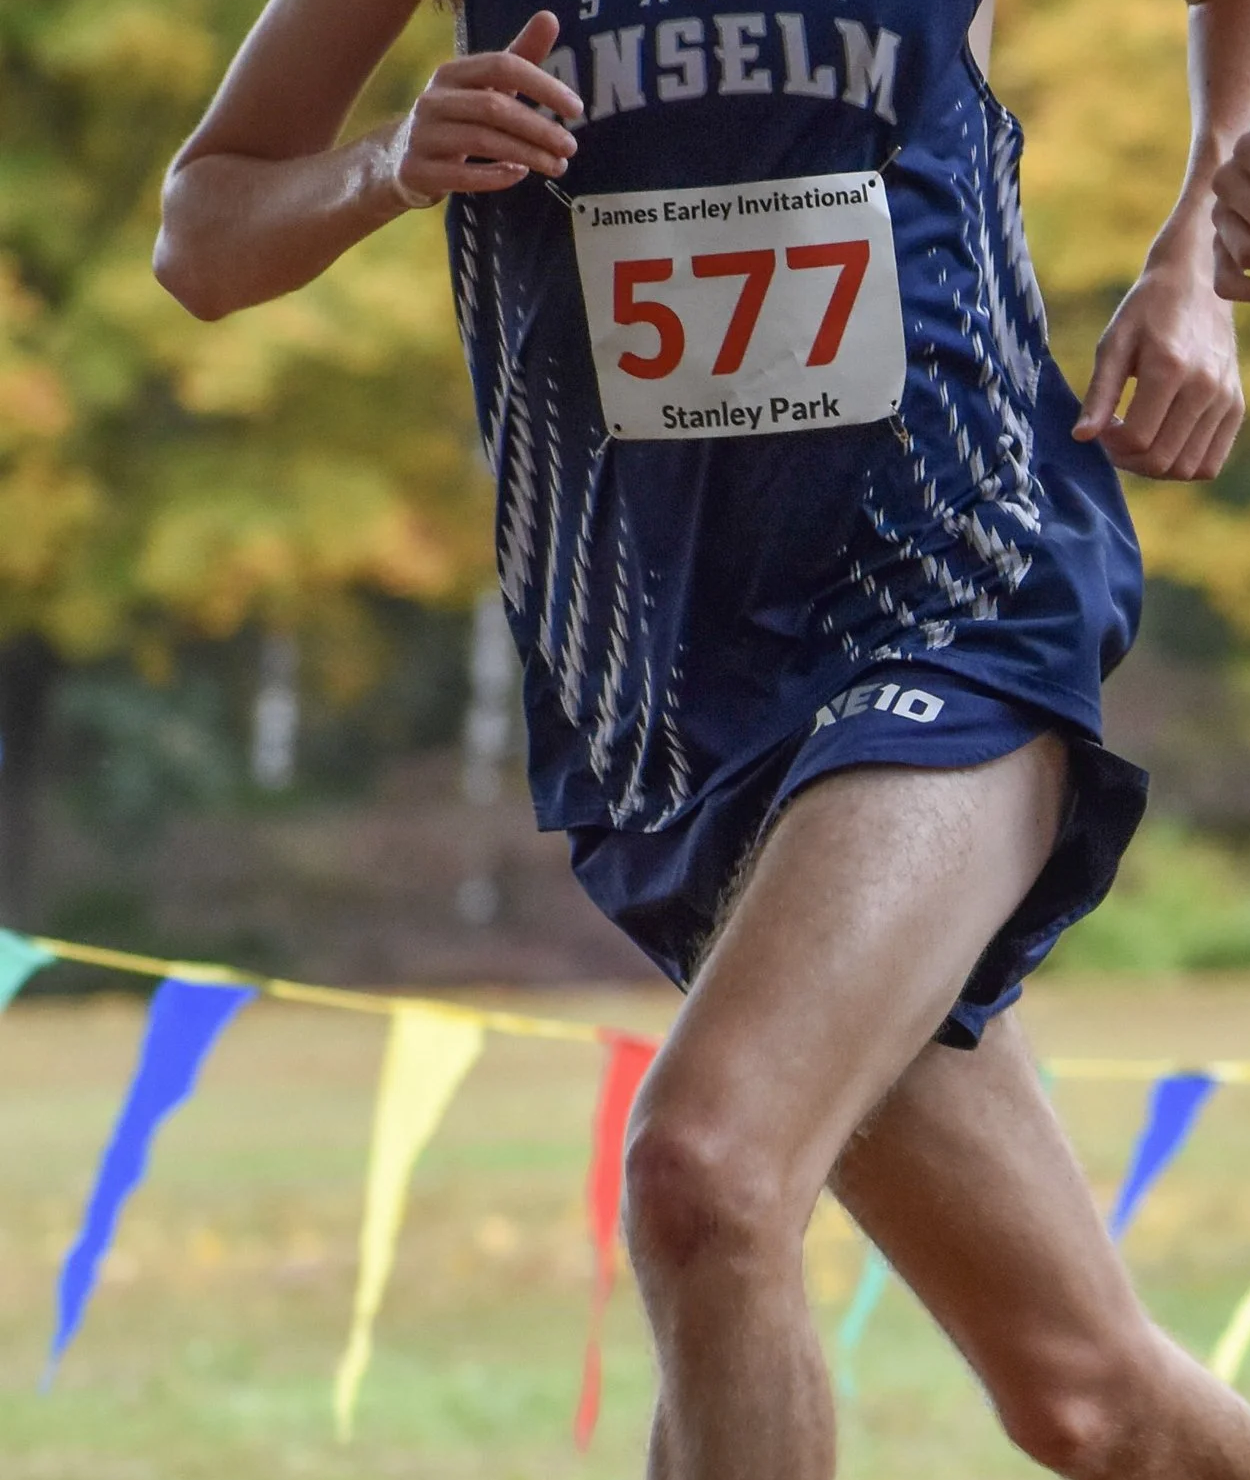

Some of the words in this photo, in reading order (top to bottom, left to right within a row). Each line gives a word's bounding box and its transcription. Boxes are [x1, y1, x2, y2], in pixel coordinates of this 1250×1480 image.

[591, 206, 658, 227] James
[663, 201, 732, 224] Earley
[737, 183, 869, 216] Invitational
[613, 239, 870, 380] 577
[661, 401, 763, 430] Stanley
[769, 392, 840, 423] Park
